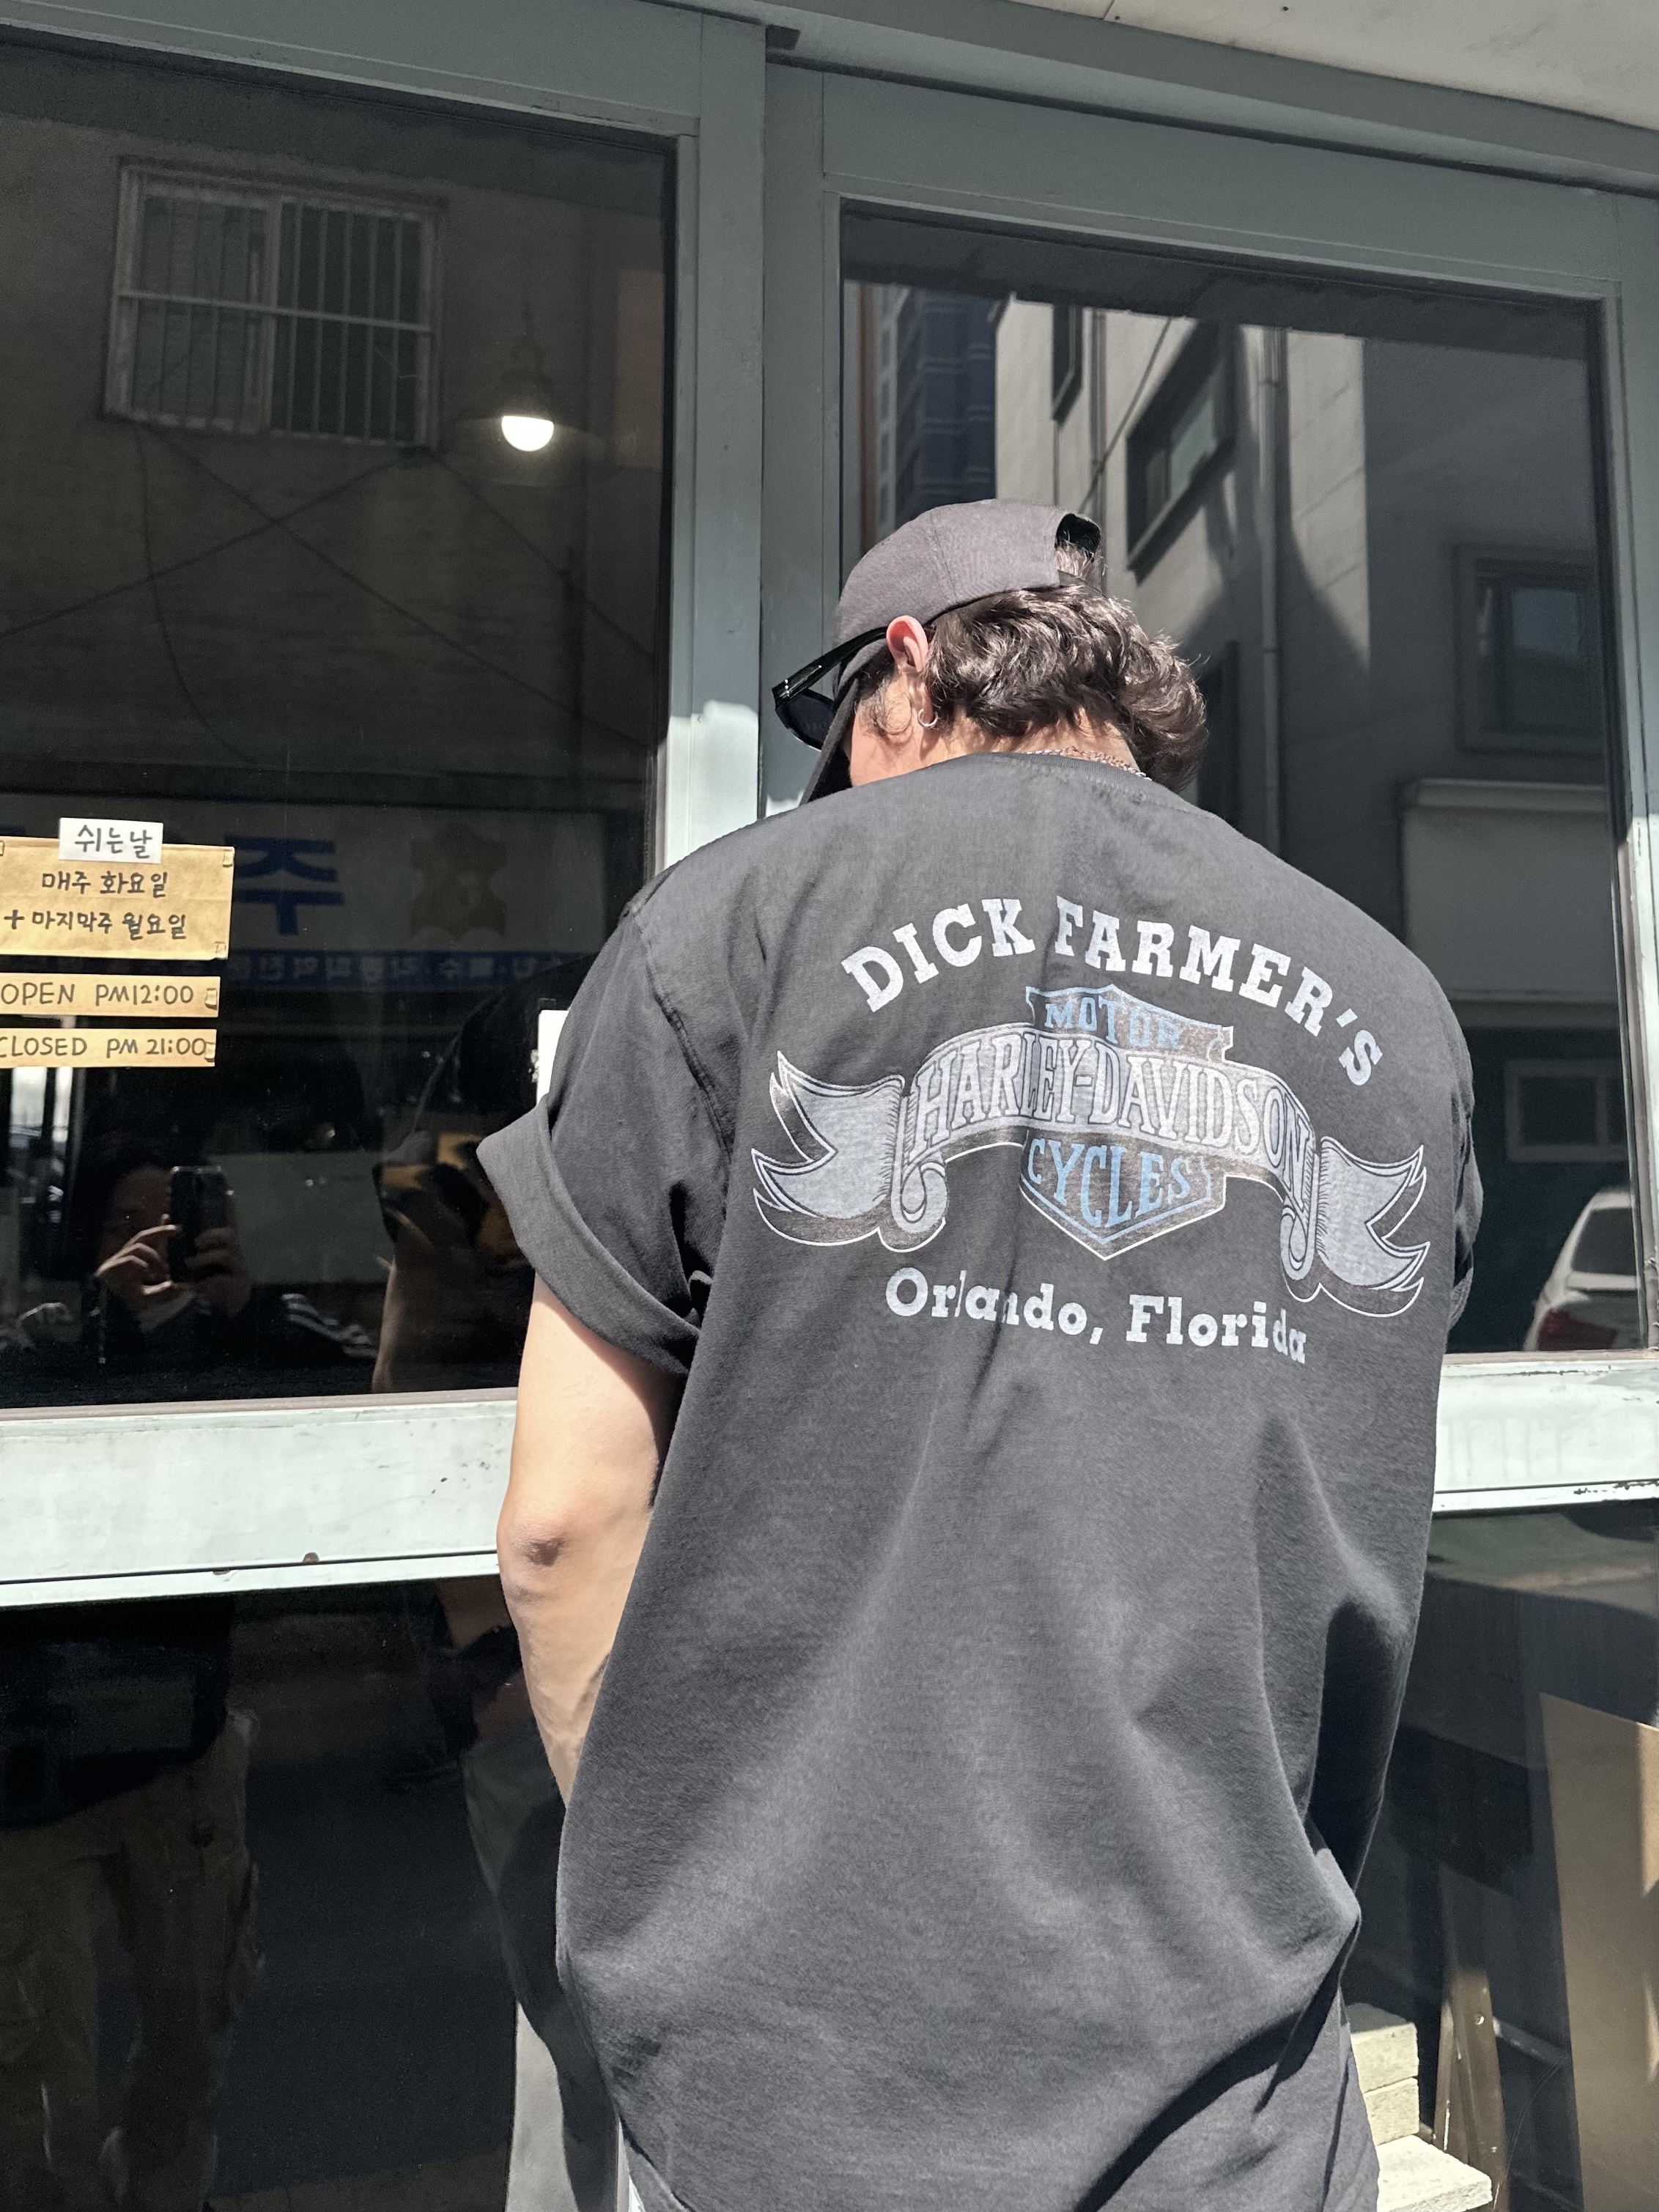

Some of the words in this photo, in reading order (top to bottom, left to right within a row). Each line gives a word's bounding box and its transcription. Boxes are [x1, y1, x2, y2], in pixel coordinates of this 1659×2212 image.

[75, 825, 153, 860] 쉬는날
[42, 871, 92, 895] 매주
[100, 871, 169, 899] 화요일
[32, 910, 114, 934] 마지막주
[122, 911, 187, 940] 월요일
[1, 981, 75, 1006] OPEN
[840, 898, 1036, 1013] DICK
[1054, 895, 1383, 1086] FARMER'S
[1045, 996, 1182, 1050] MOTOR
[106, 1038, 138, 1058] PM
[146, 1037, 207, 1055] 21:00
[909, 1031, 1310, 1211] HARLEY-DAVIDSON
[1027, 1138, 1193, 1228] CYCLES
[884, 1266, 1104, 1346] Orlando,
[1126, 1294, 1307, 1364] Florida
